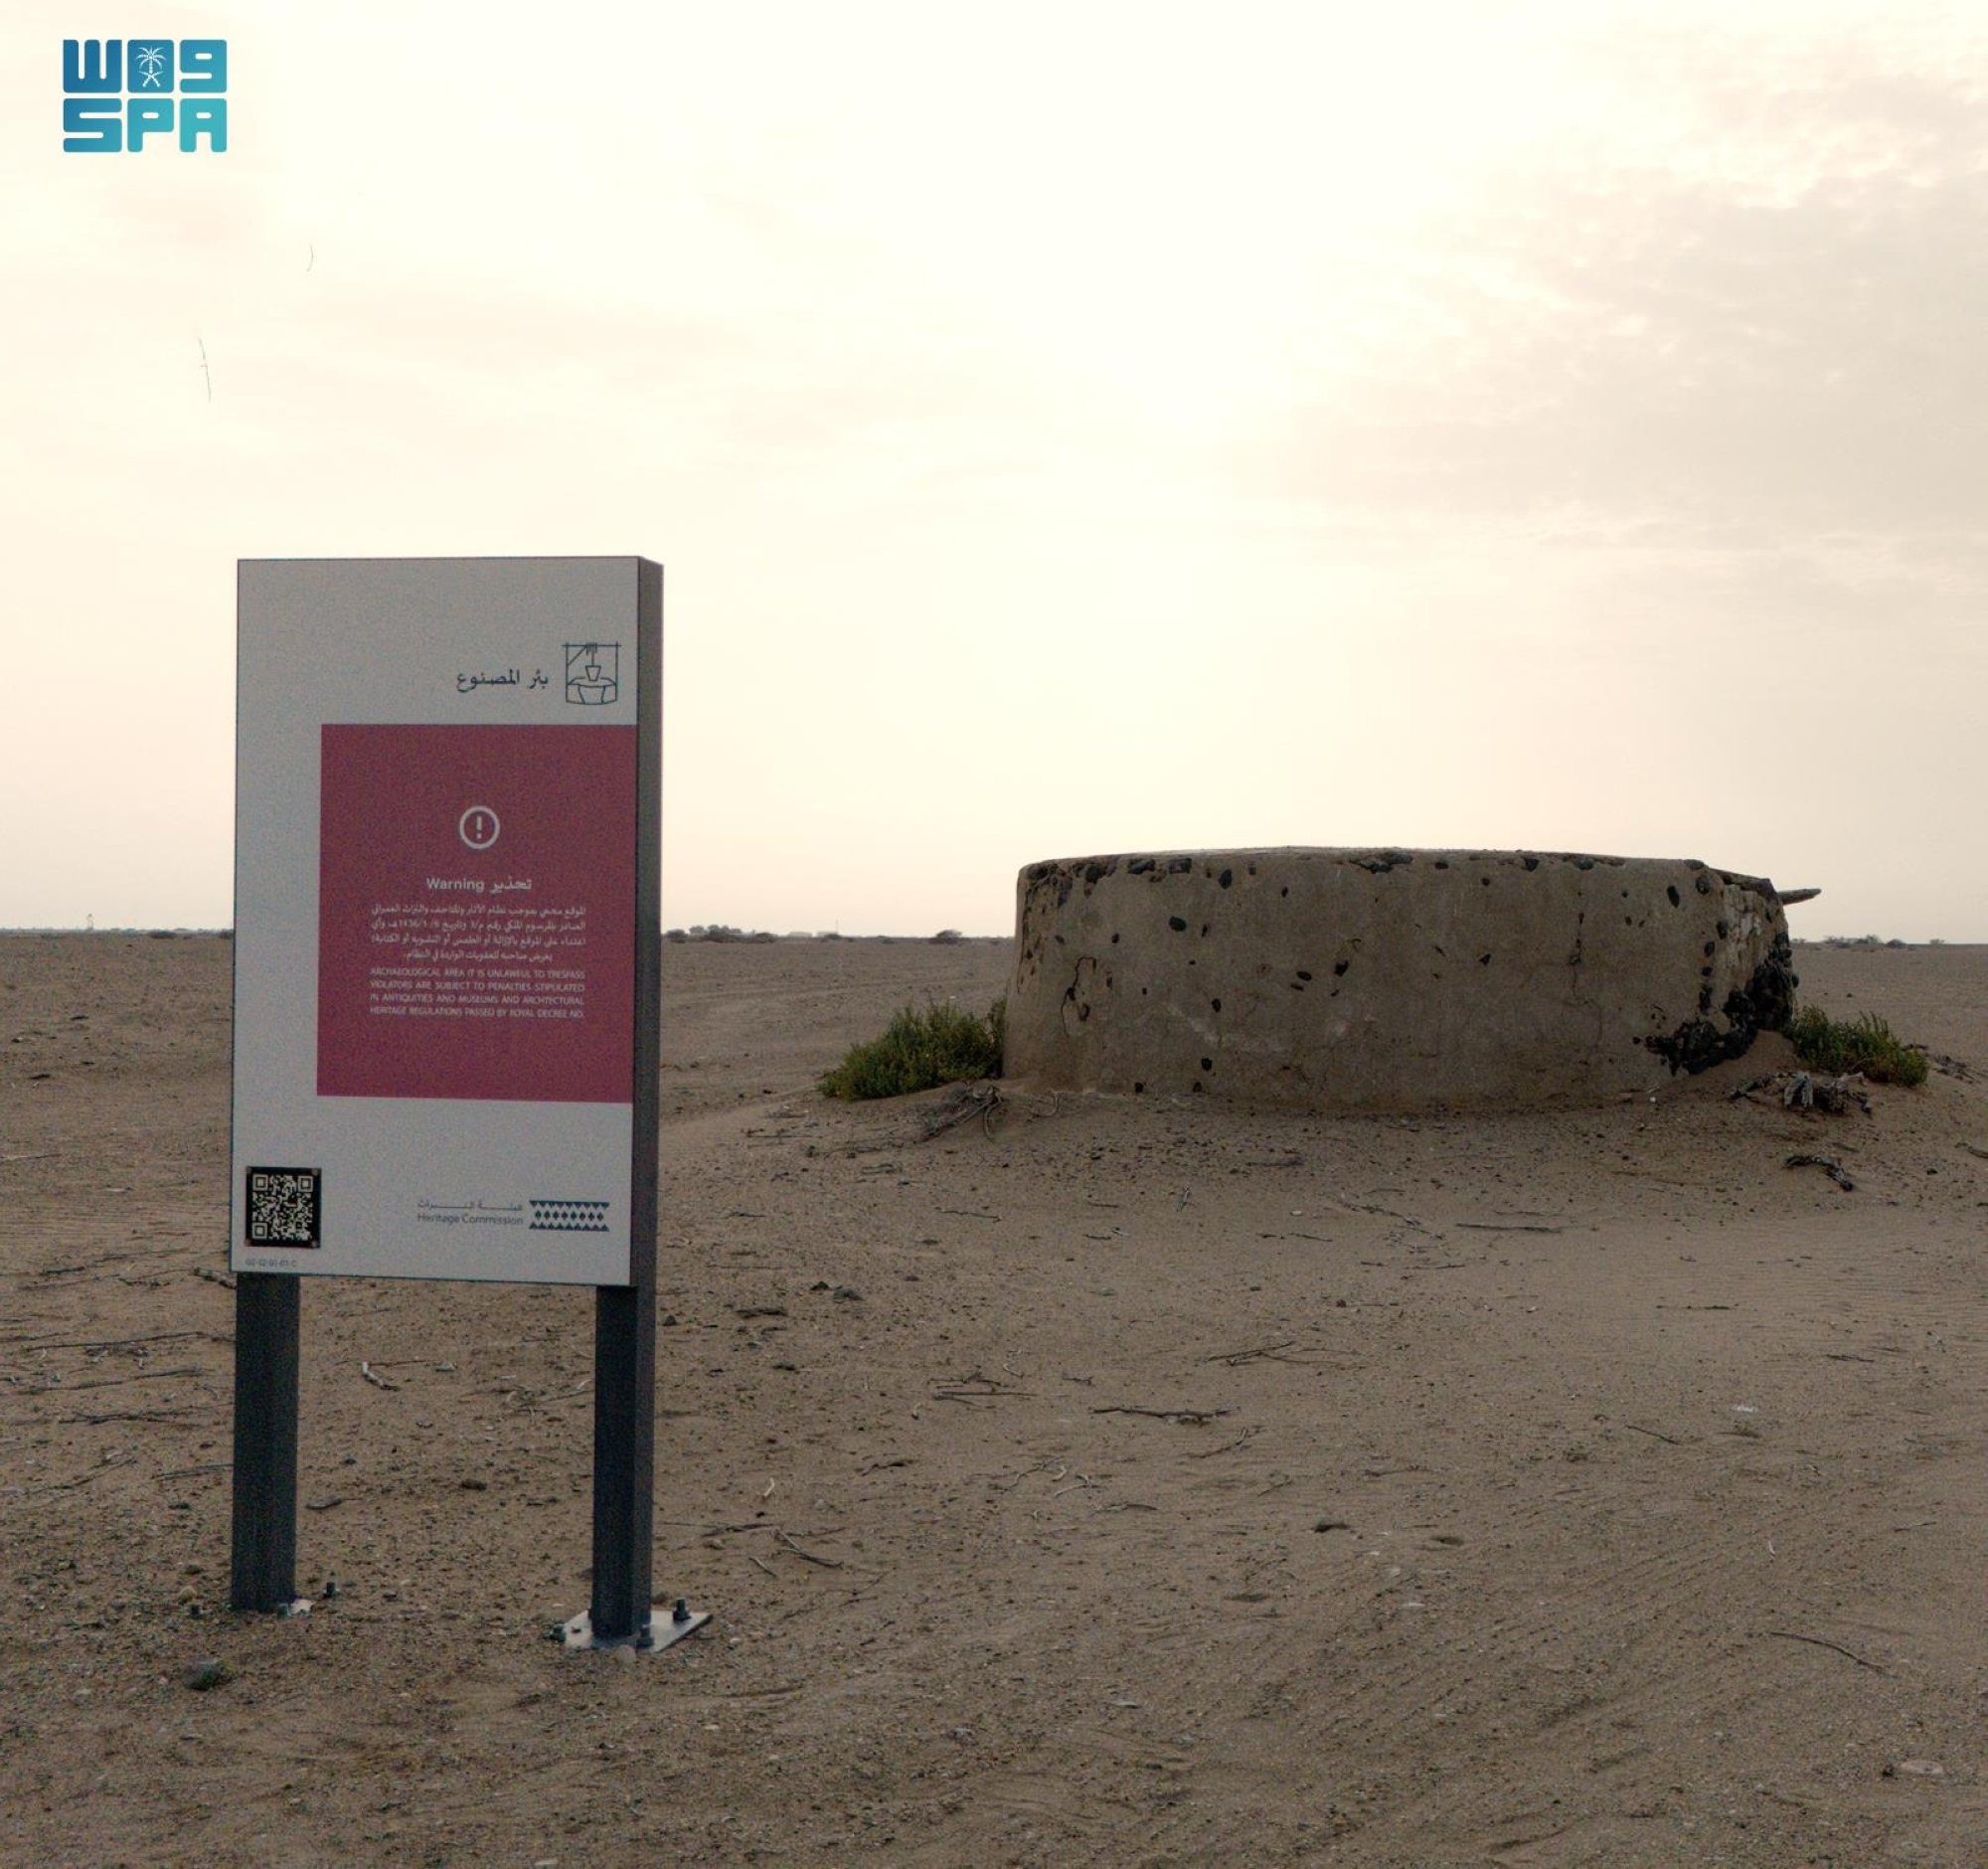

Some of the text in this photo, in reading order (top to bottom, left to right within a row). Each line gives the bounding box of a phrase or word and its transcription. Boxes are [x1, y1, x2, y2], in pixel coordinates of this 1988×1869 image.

[456, 668, 550, 693] بئر المصنوع
[425, 877, 484, 894] Warning
[489, 875, 532, 894] تحذير
[415, 980, 432, 990] ARE
[434, 981, 470, 990] SUBJECT
[487, 981, 531, 991] PENALTIES
[382, 993, 433, 1003] ANTIQUITIES
[435, 994, 456, 1003] AND
[501, 994, 520, 1004] AND
[522, 995, 585, 1005] ARCHITECTURAL
[370, 1006, 407, 1015] HERITAGE
[509, 1008, 535, 1017] ROYAL
[416, 1212, 524, 1226] Heritage Commission
